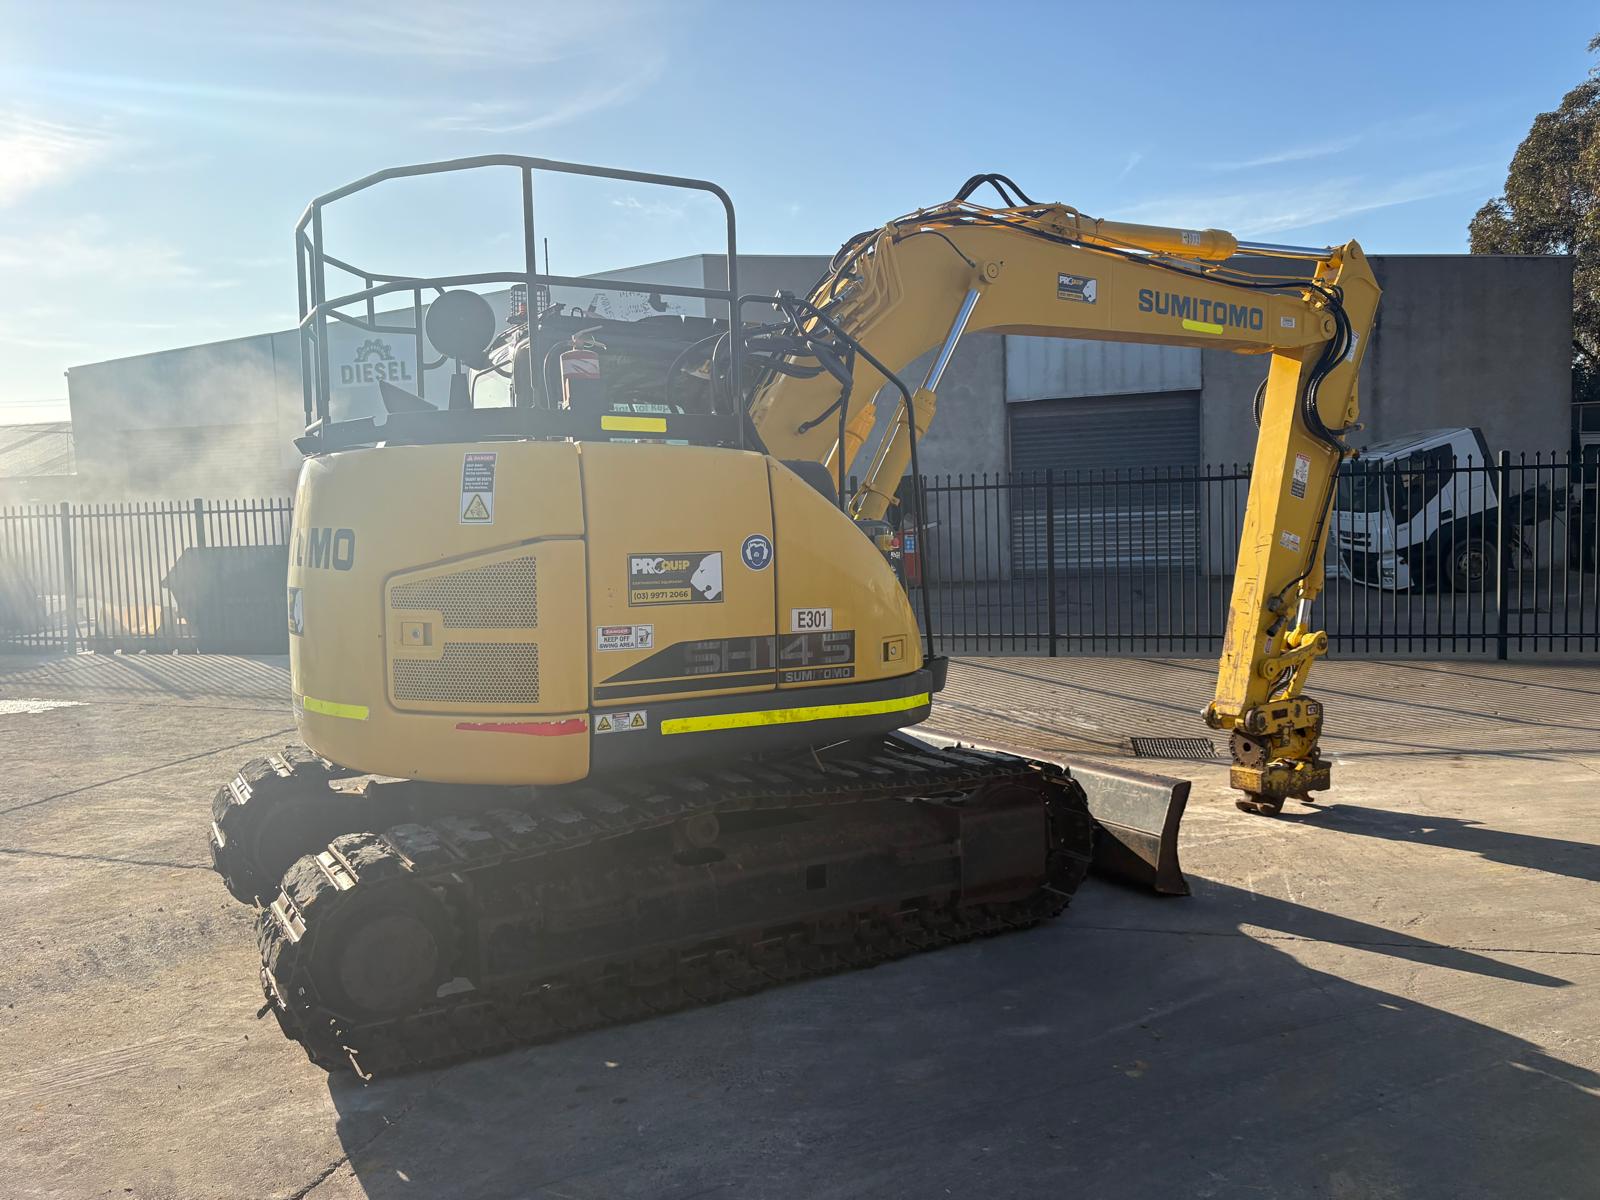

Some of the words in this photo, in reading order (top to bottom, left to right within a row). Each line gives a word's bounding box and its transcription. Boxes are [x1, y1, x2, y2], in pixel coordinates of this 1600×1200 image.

[1138, 288, 1264, 331] SUMITOMO
[340, 360, 412, 385] DIESEL
[633, 591, 649, 601] (03)
[650, 591, 668, 599] 9971
[669, 590, 689, 598] 2066
[797, 610, 826, 628] E301
